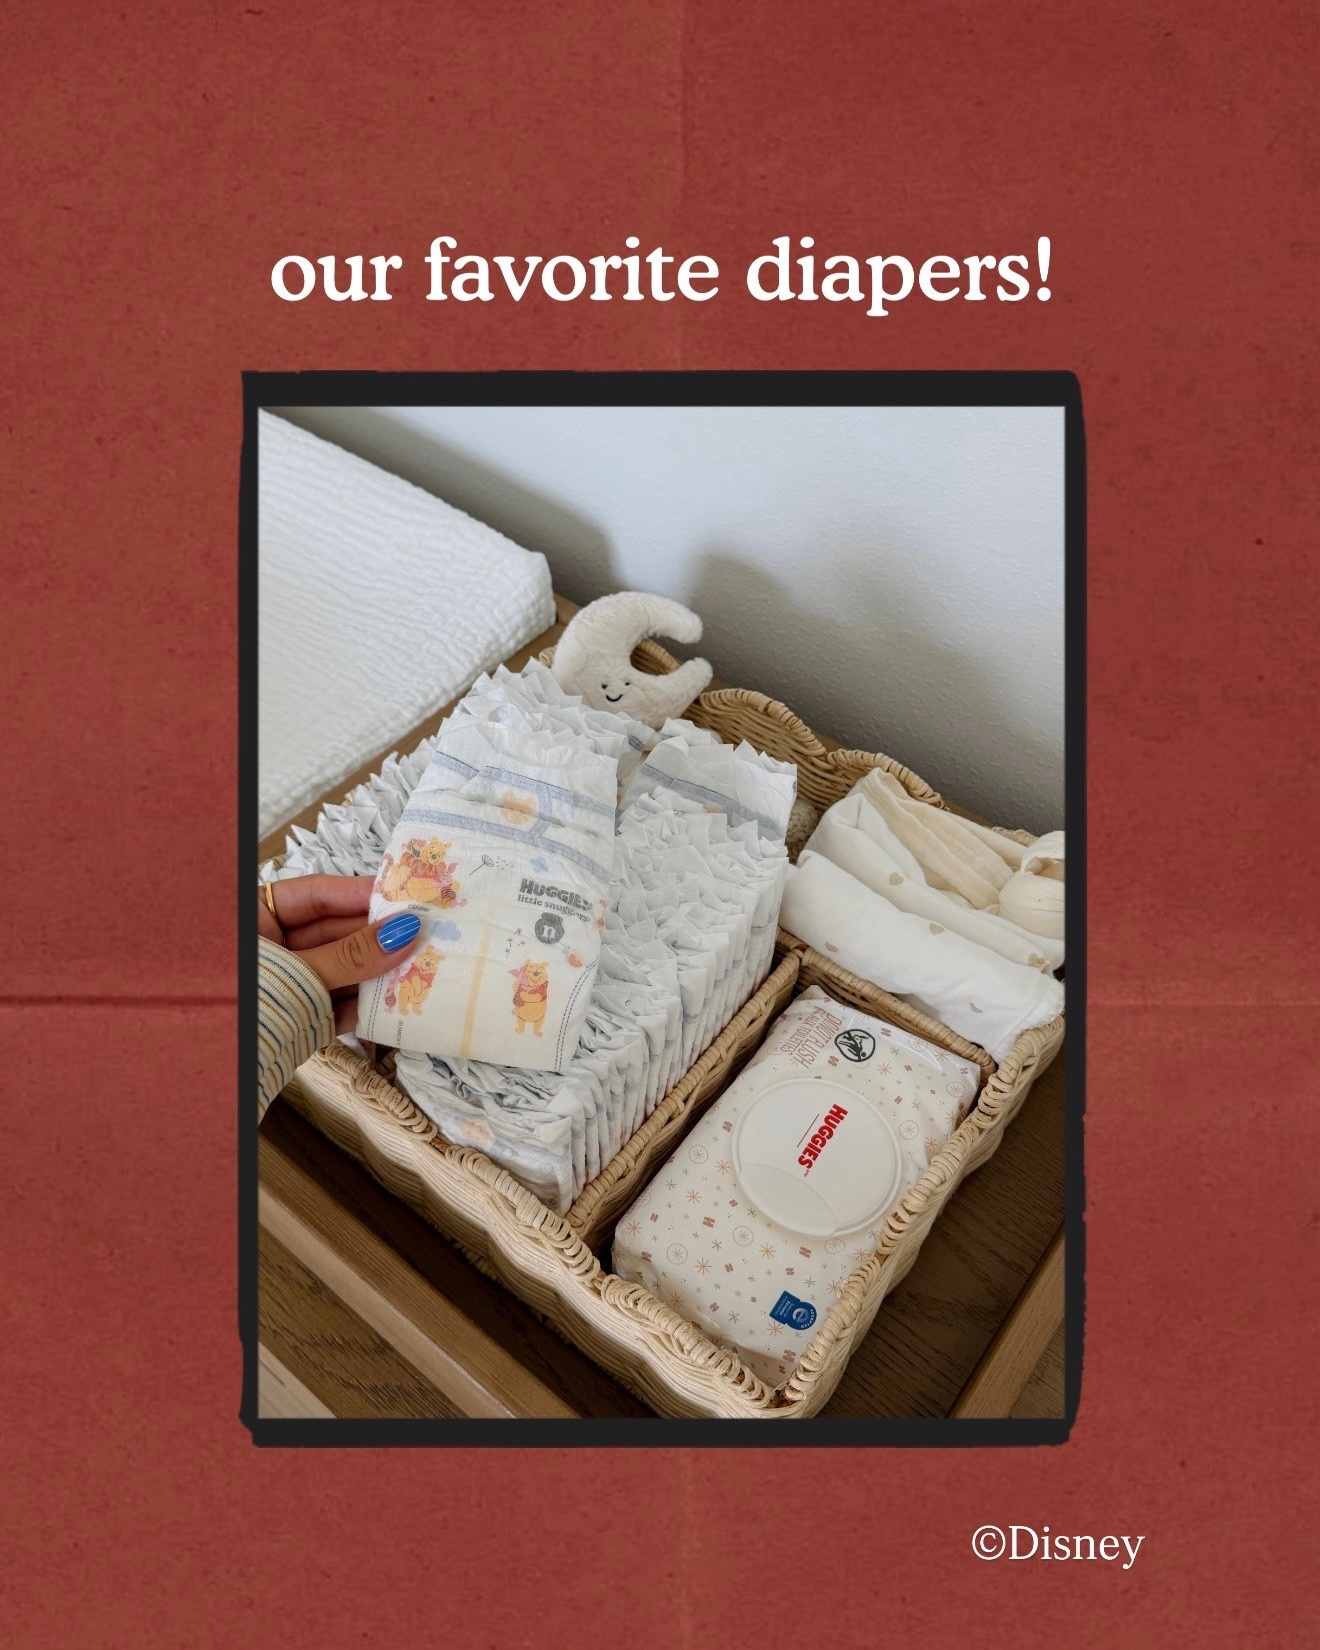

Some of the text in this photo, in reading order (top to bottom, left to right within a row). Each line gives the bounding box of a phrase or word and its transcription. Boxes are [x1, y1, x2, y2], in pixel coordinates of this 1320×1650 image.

[517, 893, 591, 922] little snuggrs
[792, 1034, 825, 1069] FLUSH
[798, 1103, 848, 1169] HUGGIES
